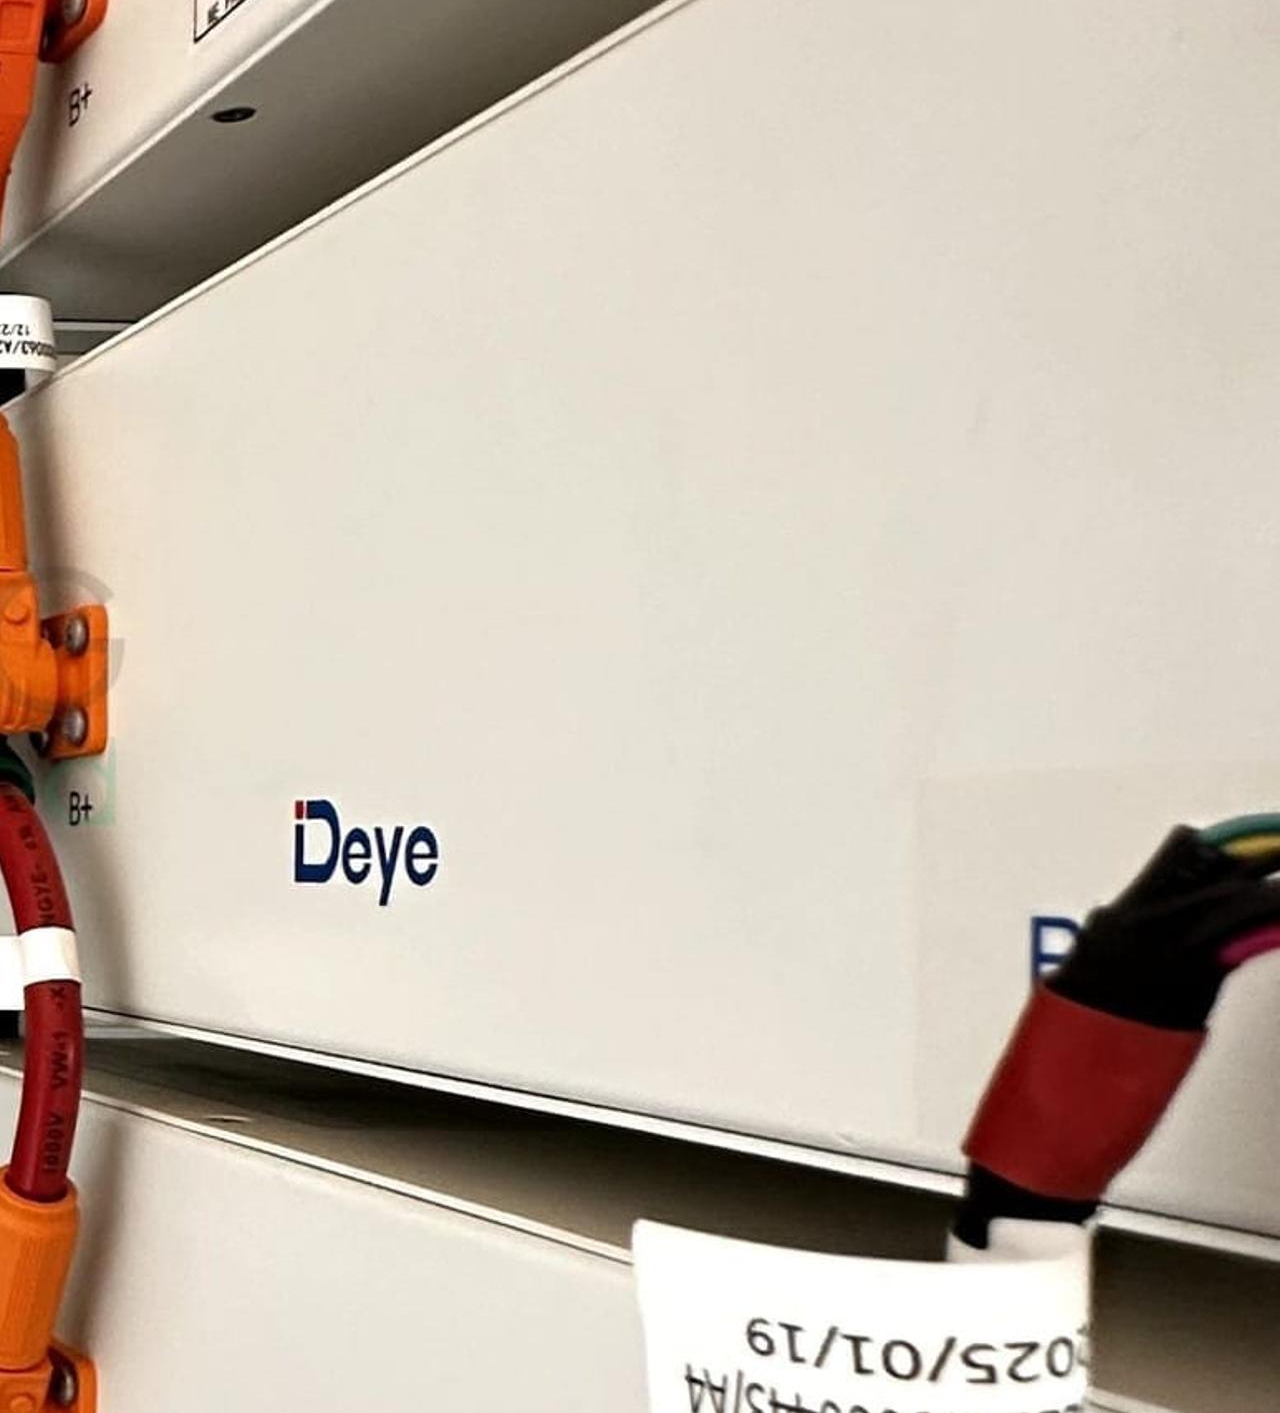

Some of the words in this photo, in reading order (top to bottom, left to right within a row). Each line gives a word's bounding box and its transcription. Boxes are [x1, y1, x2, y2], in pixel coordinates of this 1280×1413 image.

[68, 83, 93, 127] B+
[69, 790, 94, 826] B+
[295, 799, 440, 906] Deye
